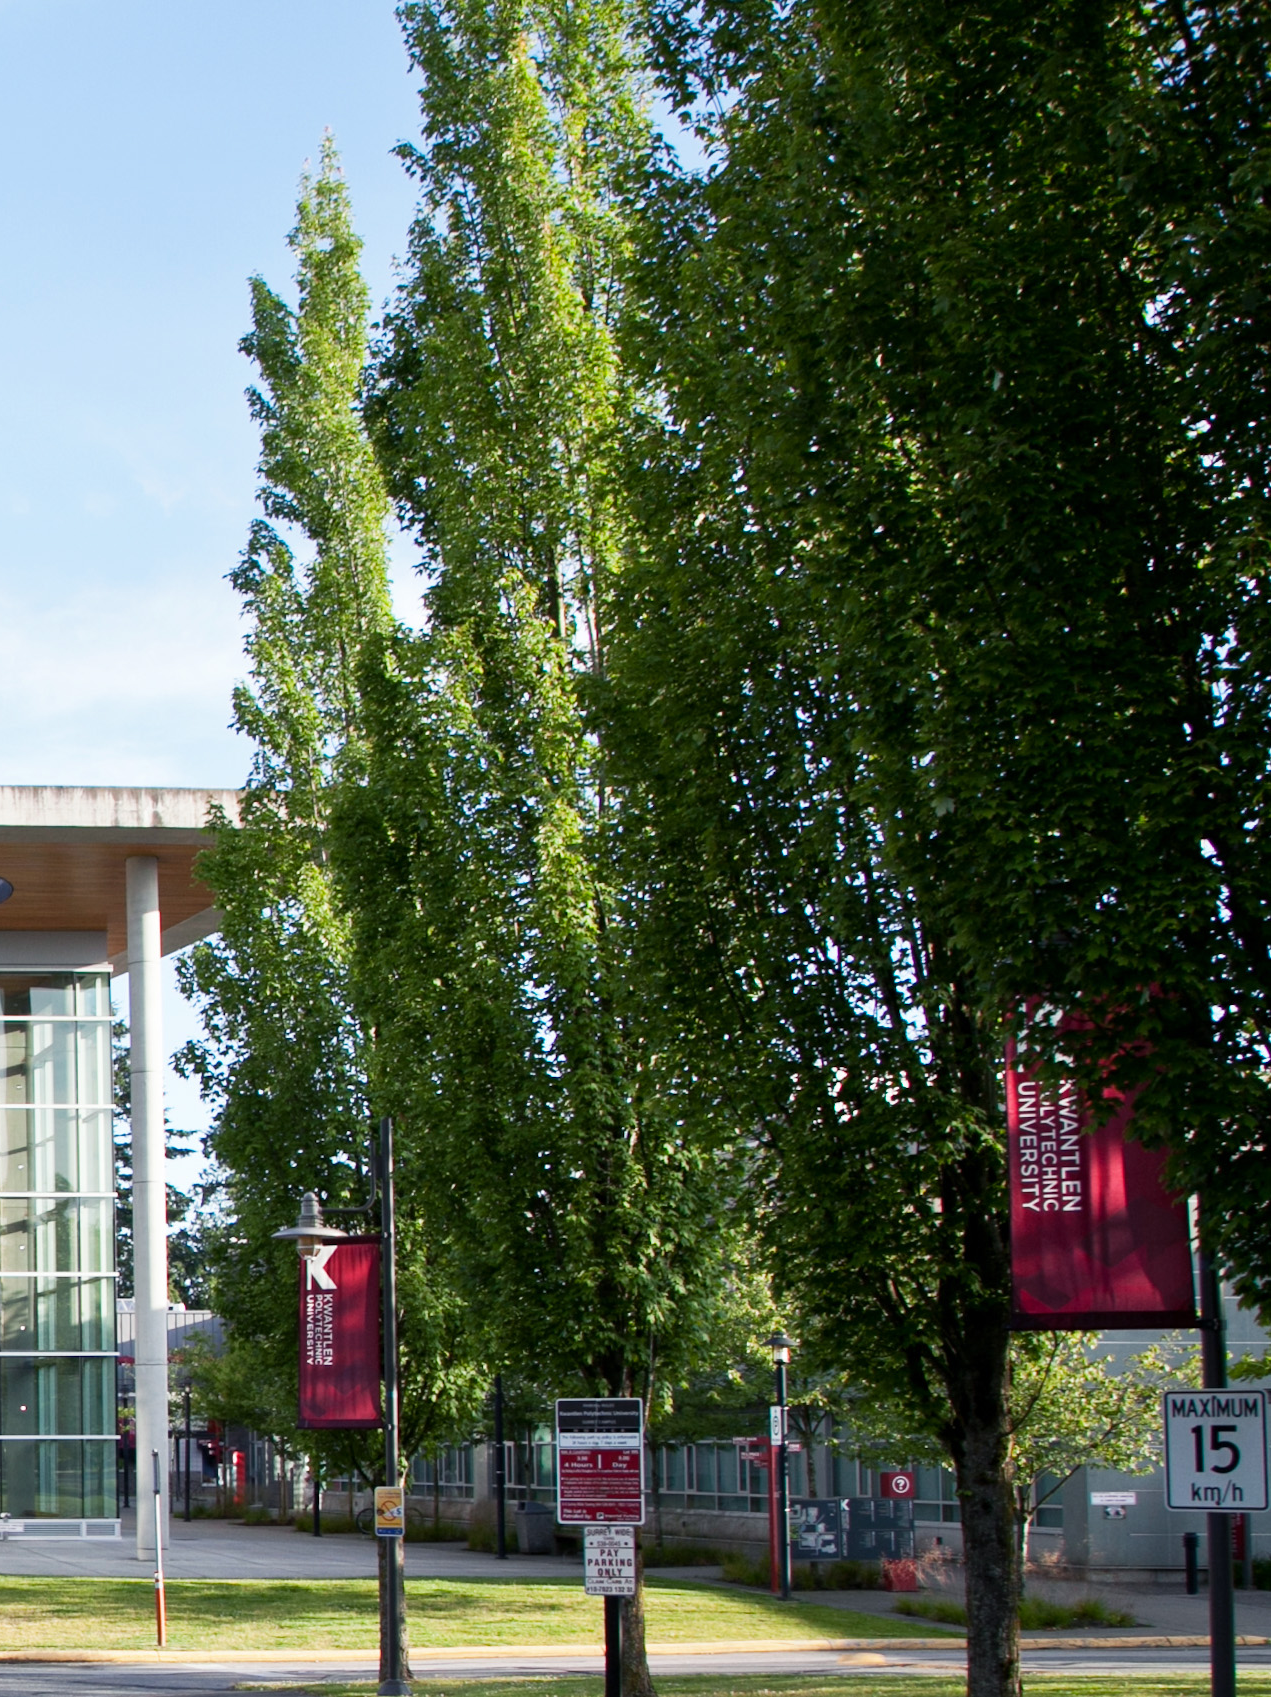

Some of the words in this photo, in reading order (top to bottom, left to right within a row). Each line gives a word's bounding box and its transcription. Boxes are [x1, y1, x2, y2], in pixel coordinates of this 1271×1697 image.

[1017, 1081, 1041, 1212] UNIVERSITY
[1039, 1081, 1059, 1212] LYTECHNIC
[306, 1245, 338, 1290] K
[306, 1294, 315, 1366] UNIVERSITY
[315, 1293, 323, 1366] POLYTECHNIC
[323, 1293, 333, 1366] KWANTLEN
[1171, 1398, 1259, 1418] MAXIMUM
[1191, 1425, 1241, 1474] 15
[1191, 1480, 1244, 1503] km/h
[587, 1528, 612, 1536] SURREY
[600, 1549, 619, 1557] PAY
[587, 1558, 633, 1567] PARKING
[597, 1568, 623, 1576] ONLY
